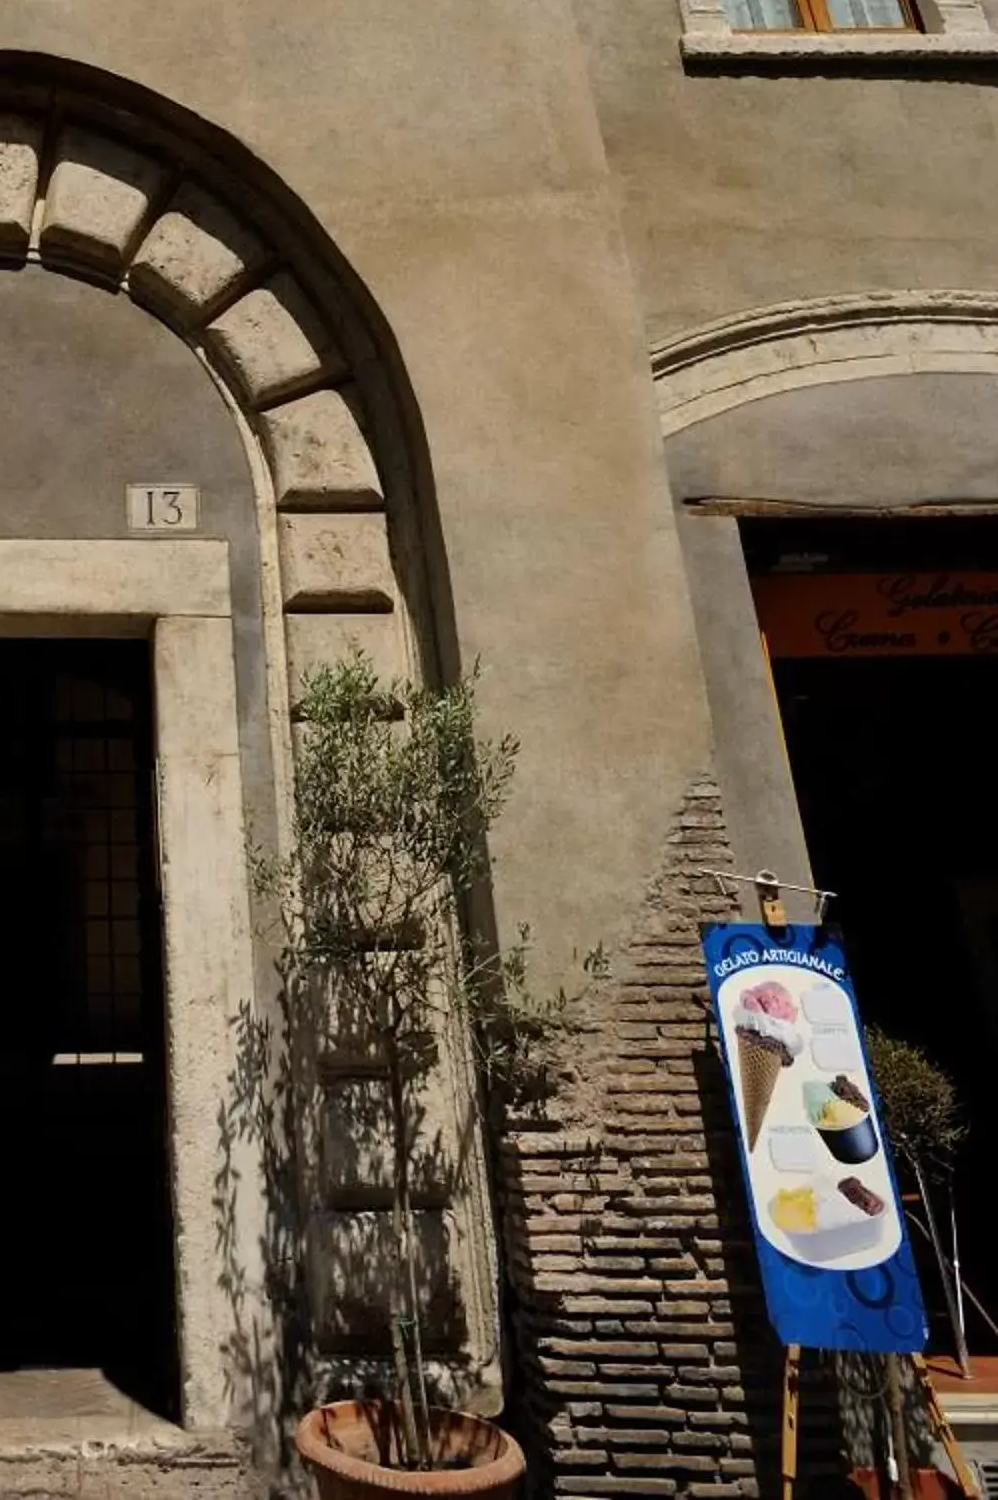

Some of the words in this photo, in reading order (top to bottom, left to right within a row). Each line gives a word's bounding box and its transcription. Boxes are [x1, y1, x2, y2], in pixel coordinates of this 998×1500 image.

[146, 491, 183, 525] 13
[713, 950, 760, 978] GELATO
[762, 948, 845, 982] ARTIGIANALE
